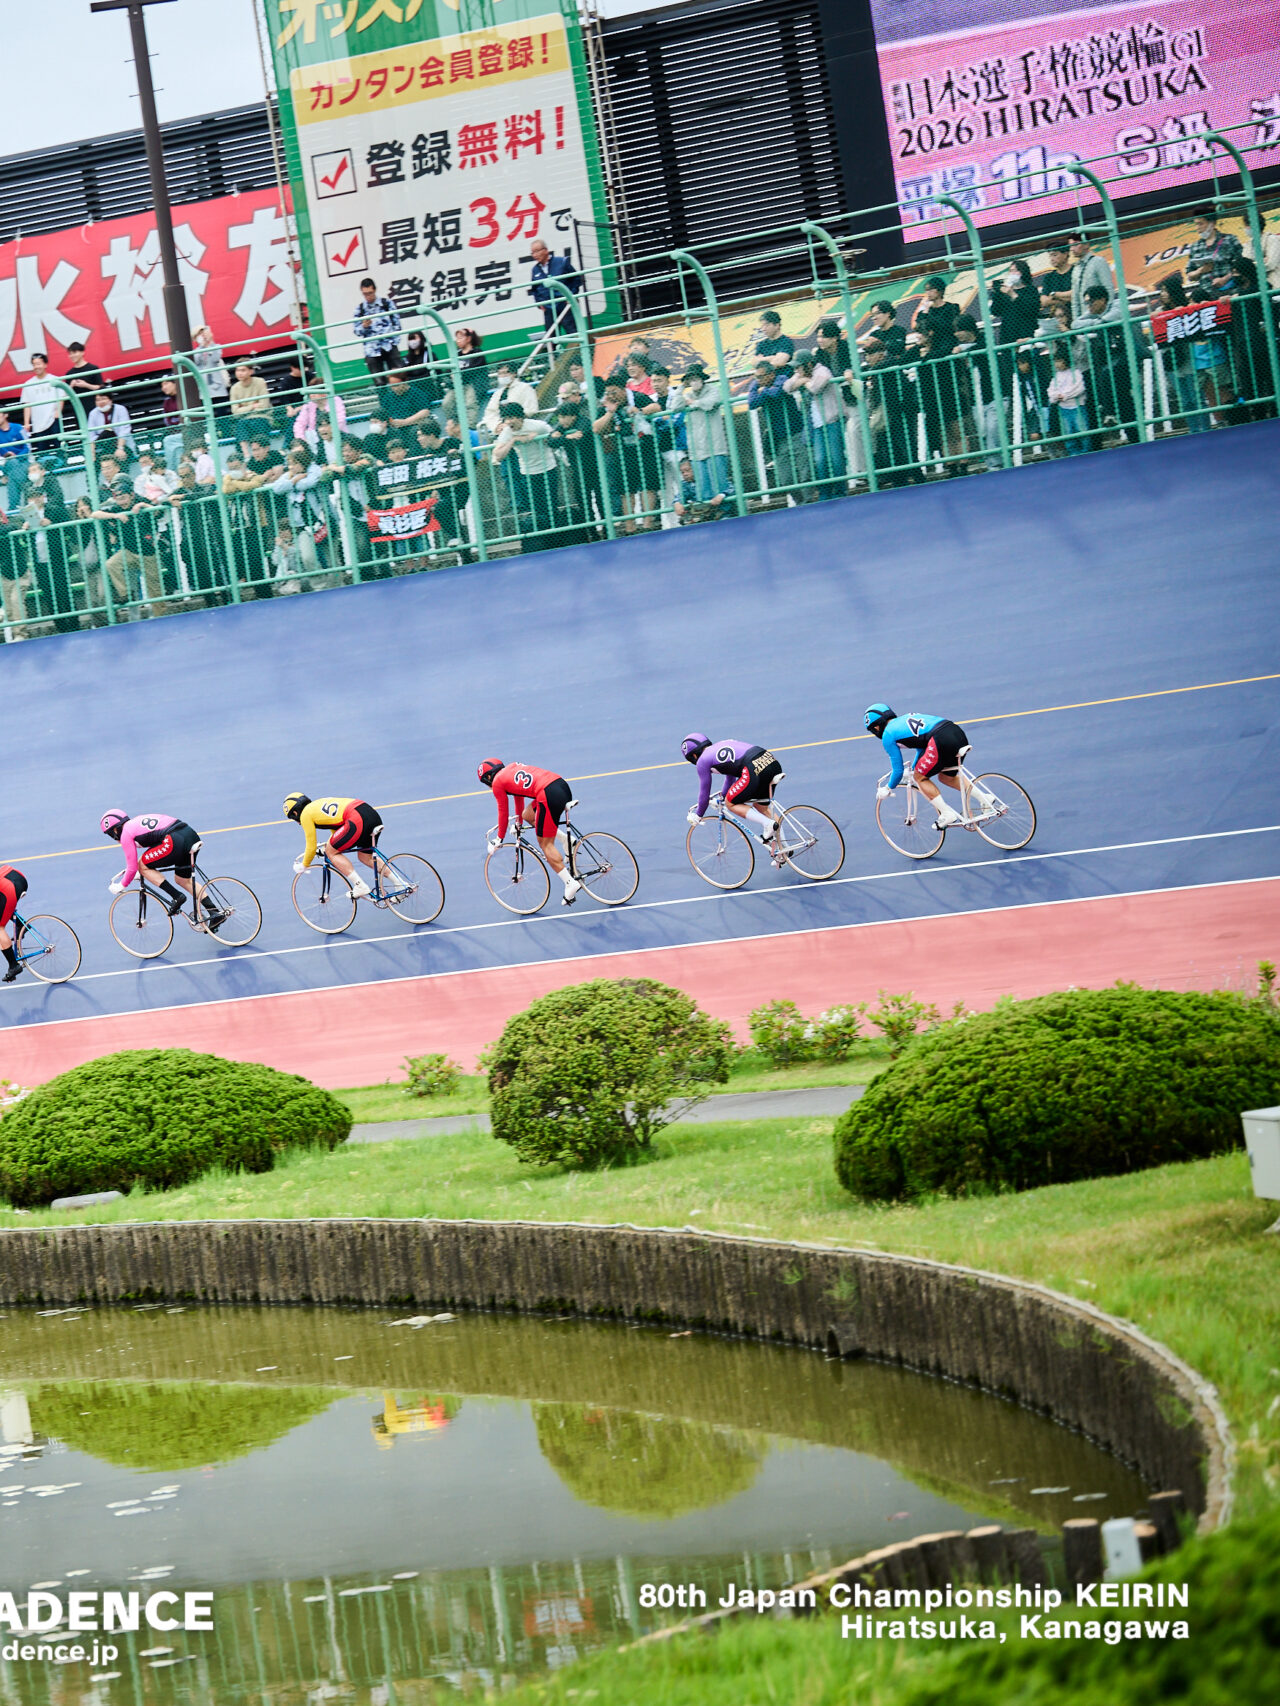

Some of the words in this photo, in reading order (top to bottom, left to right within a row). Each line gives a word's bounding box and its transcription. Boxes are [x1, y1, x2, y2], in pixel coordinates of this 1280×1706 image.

[310, 32, 549, 111] カンタン会員登録!
[898, 116, 974, 158] 2026
[982, 62, 1207, 138] HIRATSUKA
[366, 105, 565, 188] 登録無料!
[379, 192, 572, 265] 最短3分で
[906, 717, 926, 738] 4
[716, 745, 736, 764] 9
[514, 769, 534, 789] 3
[321, 801, 339, 818] 5
[141, 817, 159, 832] 8
